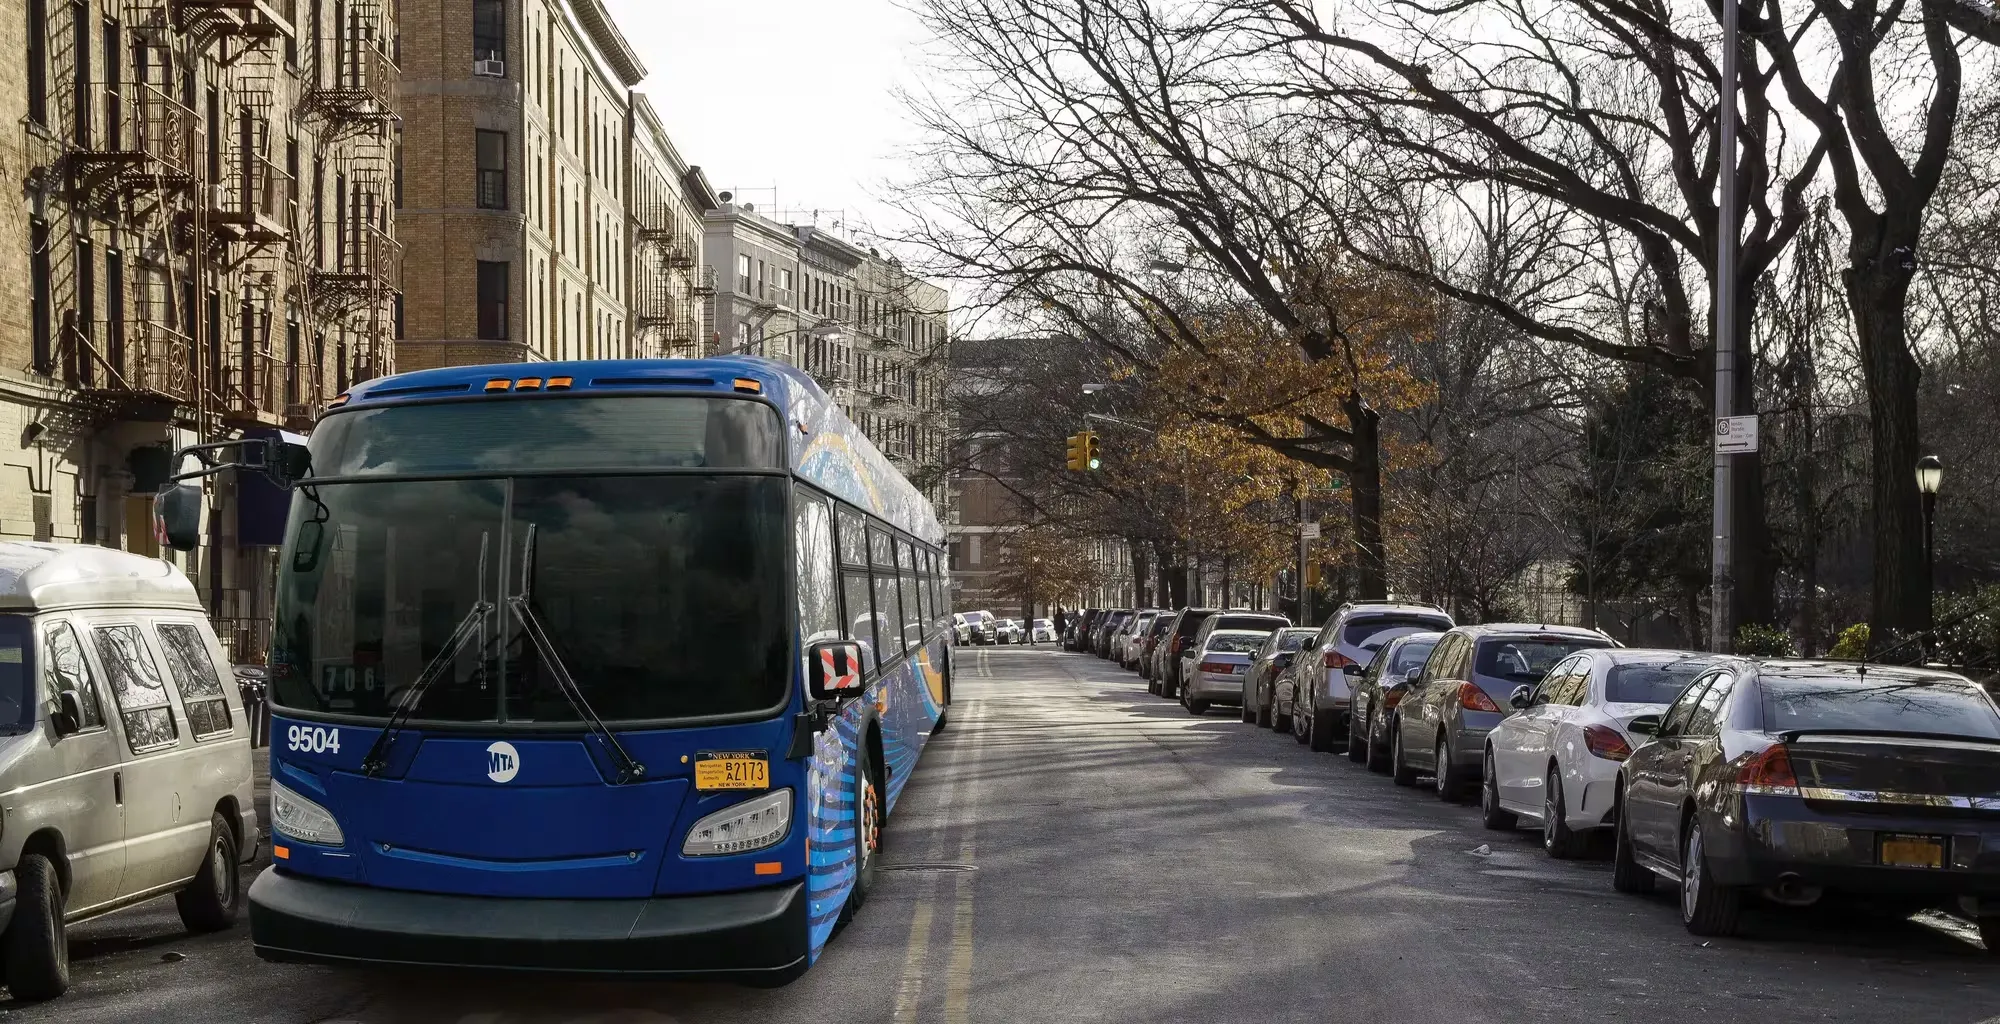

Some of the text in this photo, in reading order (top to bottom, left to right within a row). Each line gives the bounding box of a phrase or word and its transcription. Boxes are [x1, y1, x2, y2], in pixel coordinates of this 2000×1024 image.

[288, 725, 341, 754] 9504
[488, 750, 514, 774] MTA
[713, 752, 750, 760] NEW YORK
[734, 761, 764, 781] 2173
